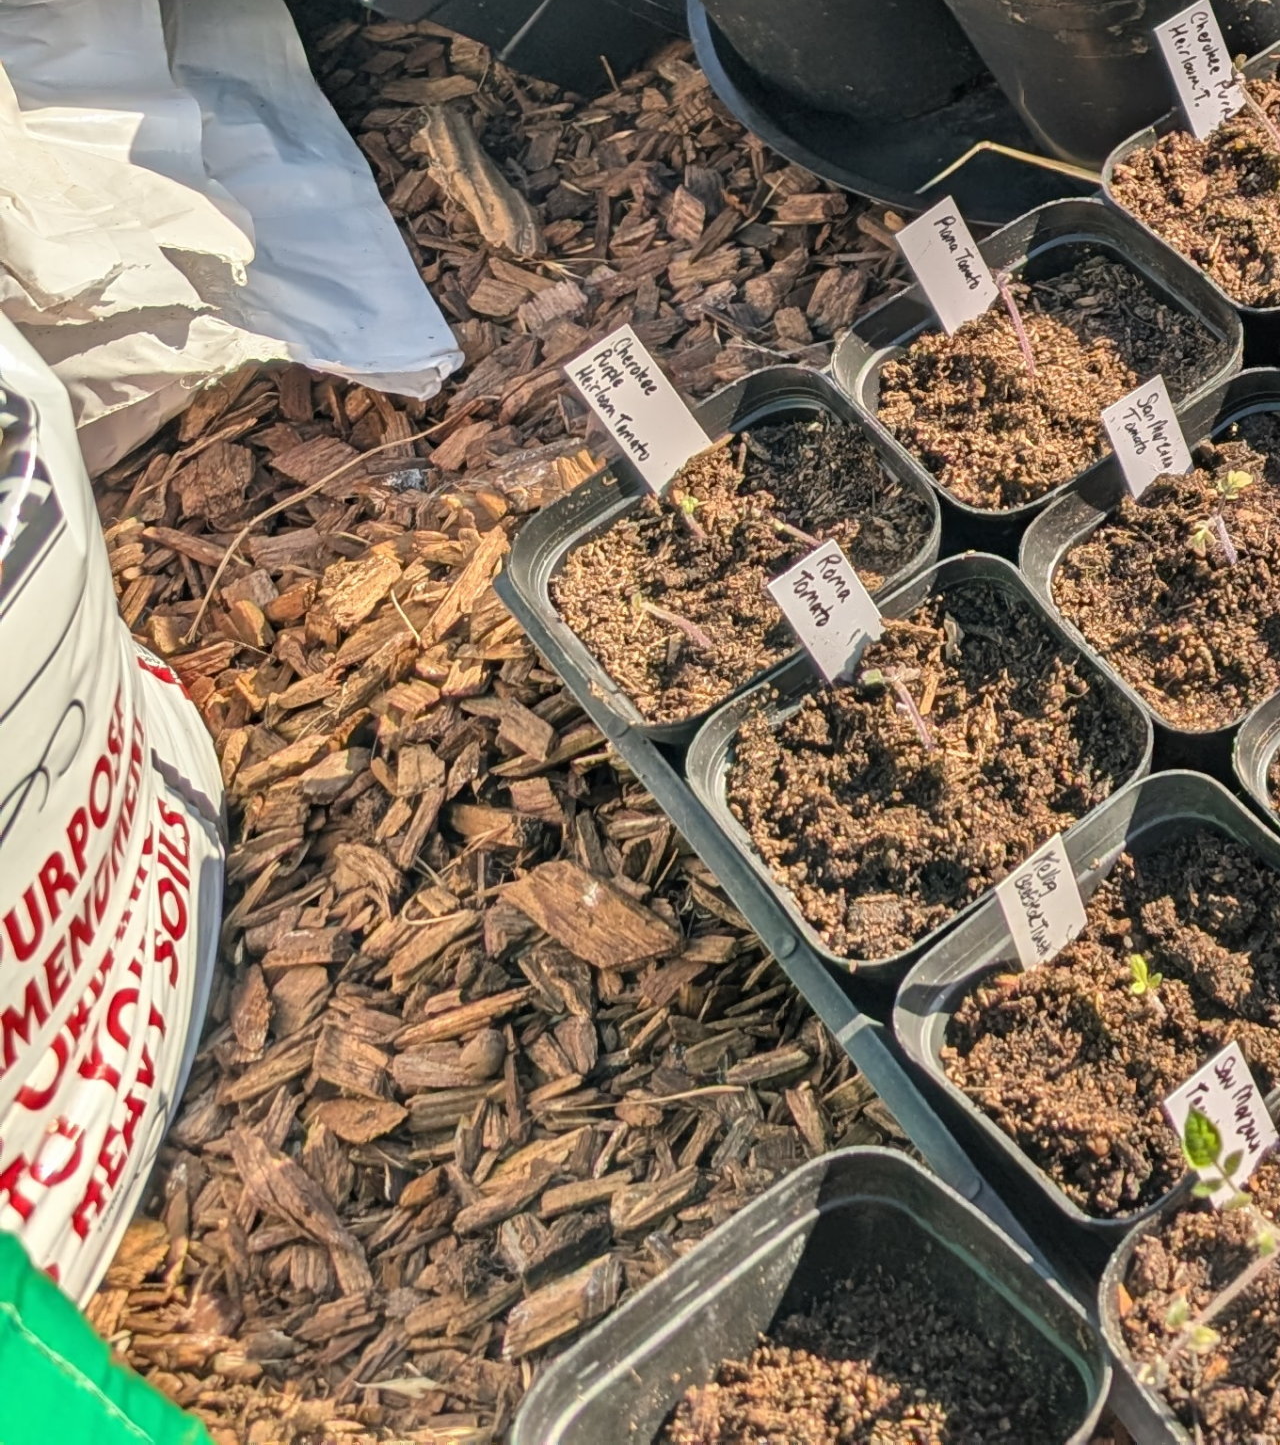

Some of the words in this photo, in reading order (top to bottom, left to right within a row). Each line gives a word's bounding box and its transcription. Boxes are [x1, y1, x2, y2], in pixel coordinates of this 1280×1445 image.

[1168, 22, 1201, 91] Heirloom
[1190, 10, 1221, 76] Cherokee
[954, 247, 983, 291] Tomato
[592, 347, 625, 390] Purple
[612, 336, 659, 397] Cherokee
[574, 364, 617, 419] Heirloom
[613, 412, 651, 463] Tomato
[1121, 406, 1150, 456] Tomato
[1136, 392, 1159, 422] San
[792, 569, 835, 628] Tomato
[815, 553, 851, 605] Roma
[2, 684, 126, 964] URPOSE
[154, 796, 193, 990] SOILS
[1214, 1055, 1237, 1092] San
